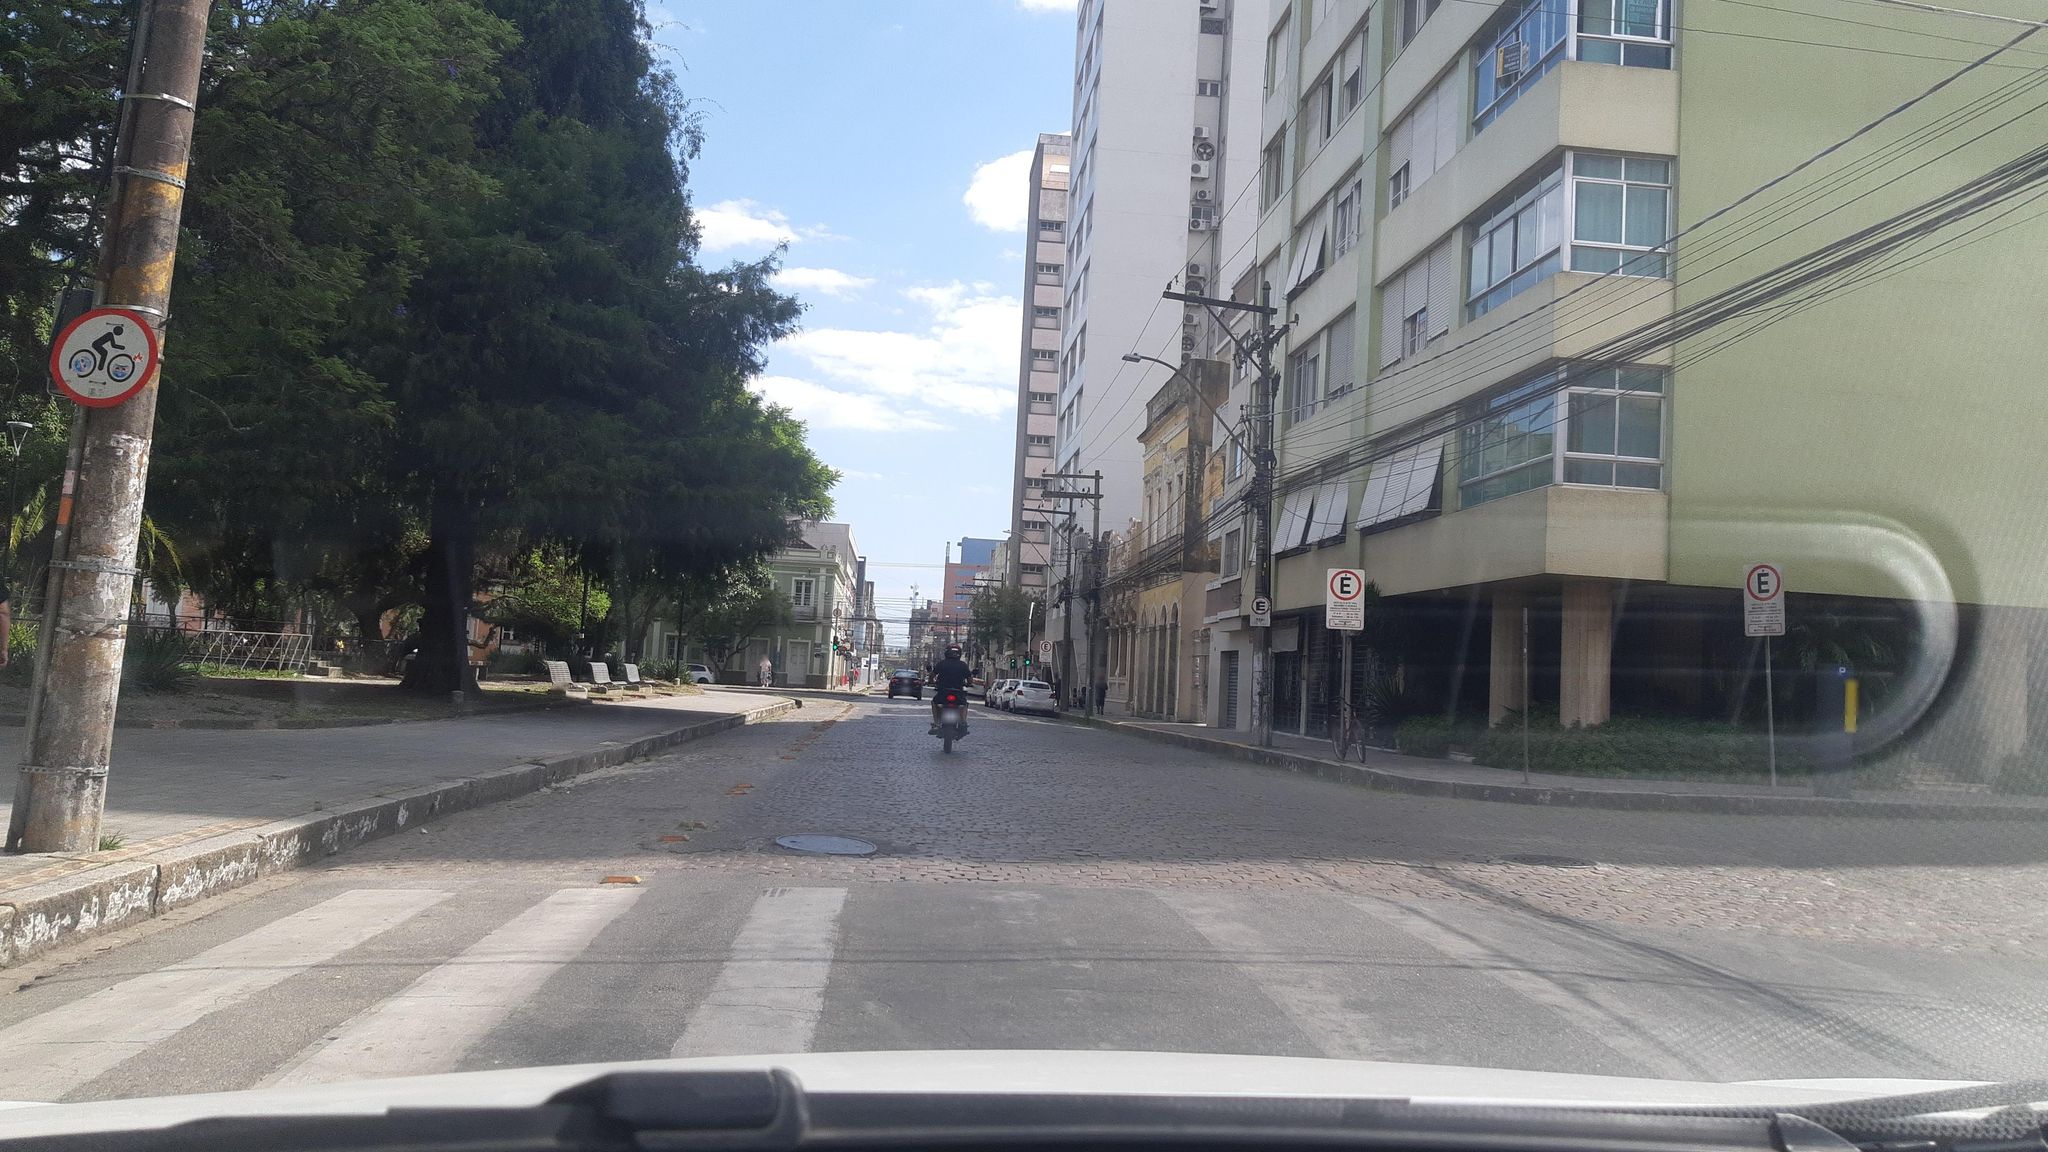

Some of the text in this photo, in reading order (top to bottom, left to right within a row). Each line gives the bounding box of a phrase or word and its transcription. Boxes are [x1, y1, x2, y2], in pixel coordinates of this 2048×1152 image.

[1340, 577, 1352, 594] E
[1757, 572, 1770, 593] E
[1256, 601, 1266, 611] E
